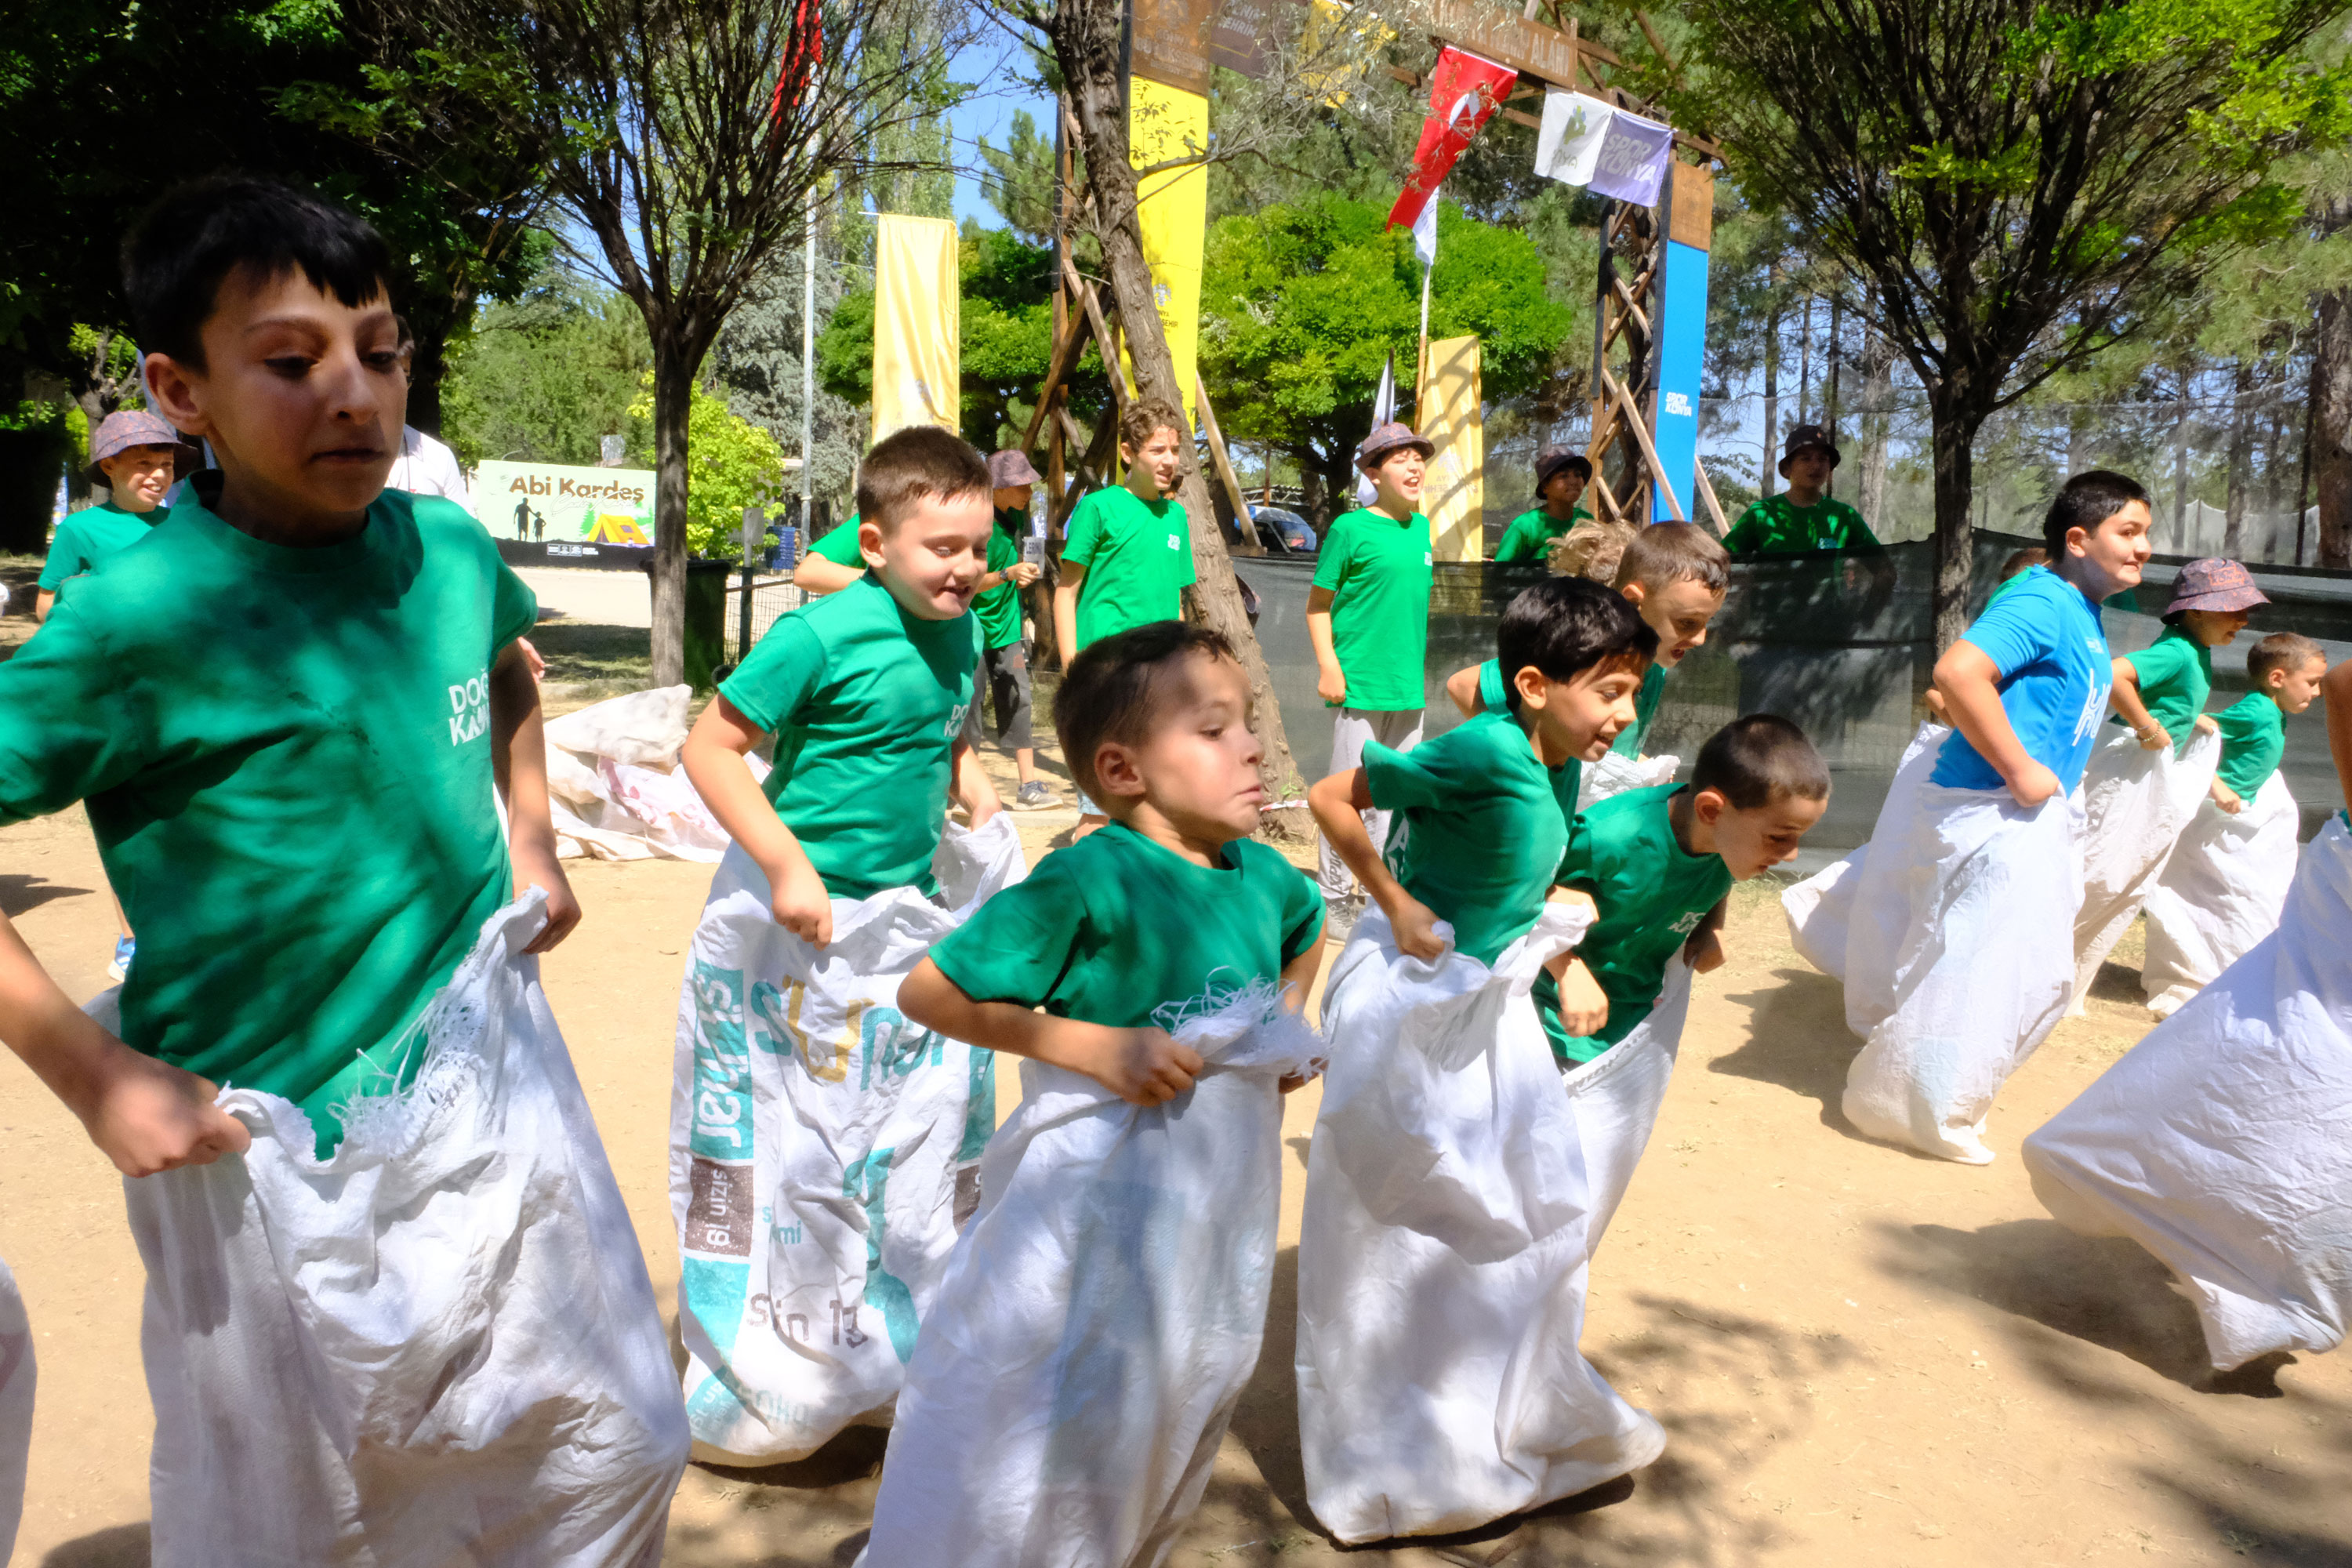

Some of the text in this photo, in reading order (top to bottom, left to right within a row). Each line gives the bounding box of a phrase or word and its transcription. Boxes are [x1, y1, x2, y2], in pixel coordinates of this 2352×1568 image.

[1604, 133, 1652, 160] SPOR
[1595, 149, 1657, 185] KONYA
[1665, 391, 1688, 405] SPOR
[1665, 401, 1693, 417] KONYA
[509, 475, 552, 496] Abi
[448, 666, 489, 714] DOĞ
